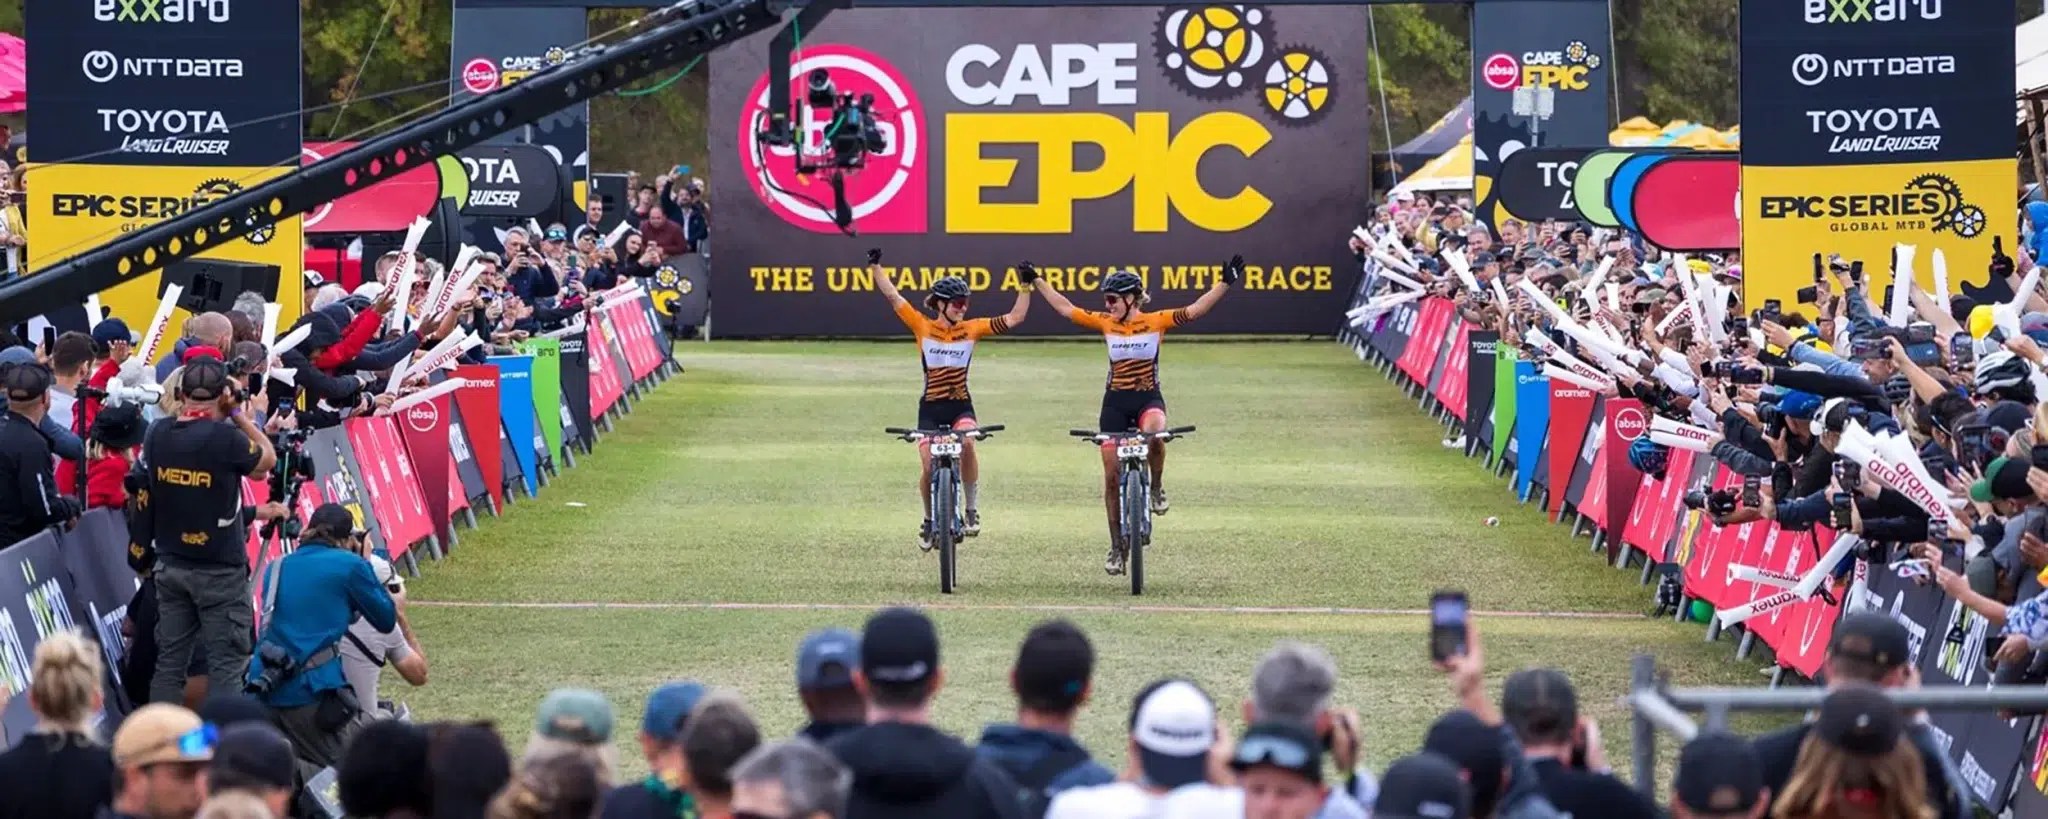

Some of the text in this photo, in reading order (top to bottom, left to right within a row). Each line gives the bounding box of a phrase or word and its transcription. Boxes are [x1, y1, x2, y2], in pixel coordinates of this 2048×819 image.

[123, 58, 173, 76] NTT
[1523, 51, 1562, 65] CAPE
[1834, 58, 1885, 77] NTT
[945, 43, 1137, 105] CAPE
[1488, 64, 1514, 76] absa
[1522, 65, 1589, 90] EPIC
[97, 109, 230, 133] TOYOTA
[1806, 107, 1940, 133] TOYOTA
[945, 111, 1274, 233] EPIC
[53, 194, 115, 216] EPIC
[469, 190, 520, 208] RUISER
[1761, 193, 1940, 218] EPIC SERIES
[1830, 221, 1926, 232] GLOBAL MTB
[751, 267, 814, 291] THE
[1001, 266, 1149, 291] ARICN
[1244, 266, 1332, 290] RACE
[436, 267, 462, 313] aramex
[1554, 389, 1591, 398] aramex
[411, 407, 435, 420] absa
[1618, 416, 1643, 429] absa
[1676, 426, 1710, 442] aram
[158, 466, 212, 488] MEDIA
[1896, 462, 1949, 519] aramex
[1750, 592, 1801, 614] ramex
